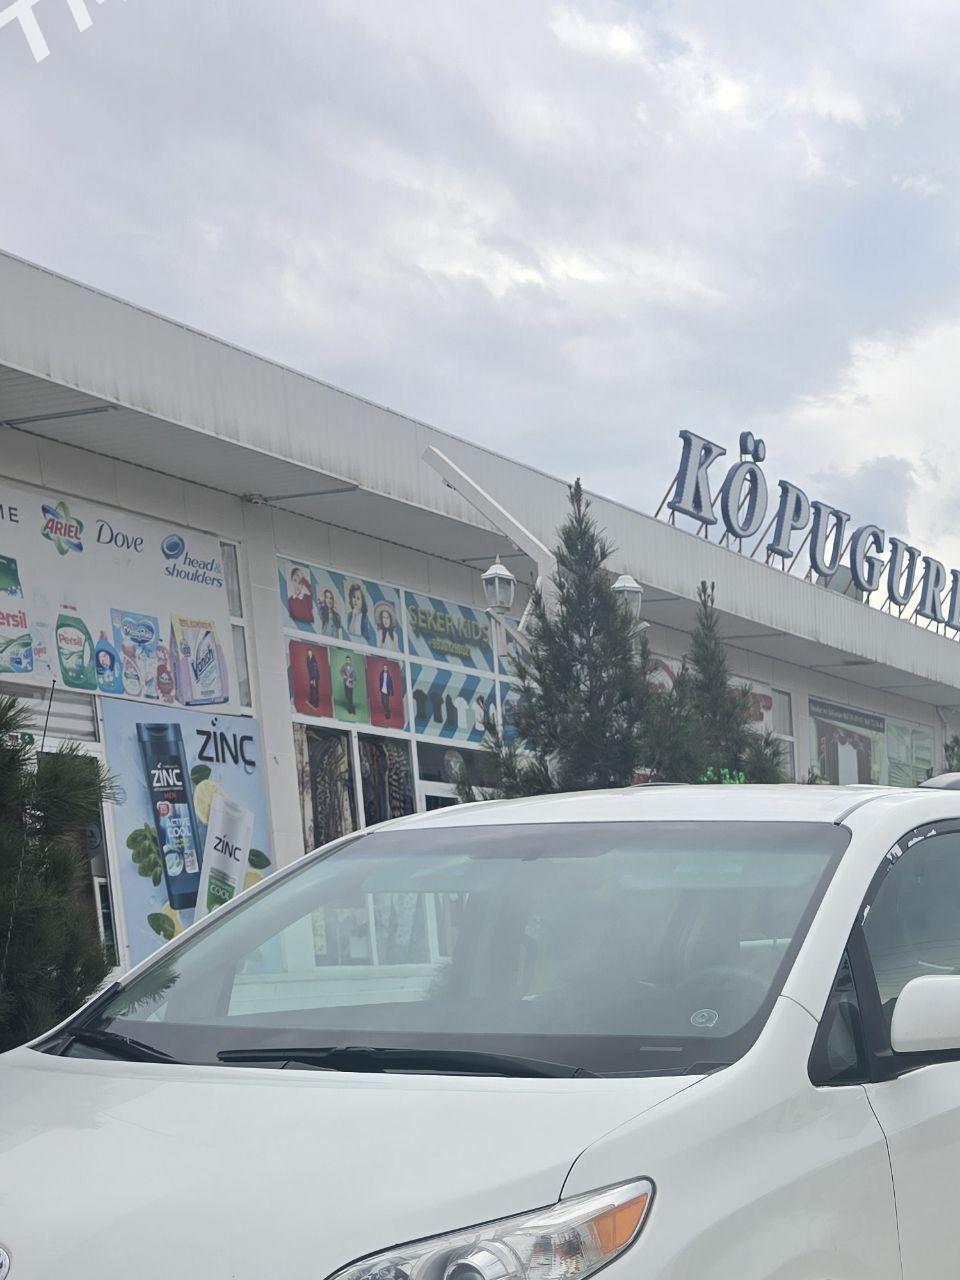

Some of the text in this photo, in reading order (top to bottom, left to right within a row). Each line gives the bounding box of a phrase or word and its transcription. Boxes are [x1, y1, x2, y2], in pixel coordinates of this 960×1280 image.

[43, 518, 82, 540] ARIEL
[96, 519, 144, 553] Dove
[164, 563, 223, 588] shoulders
[59, 632, 83, 647] Persil
